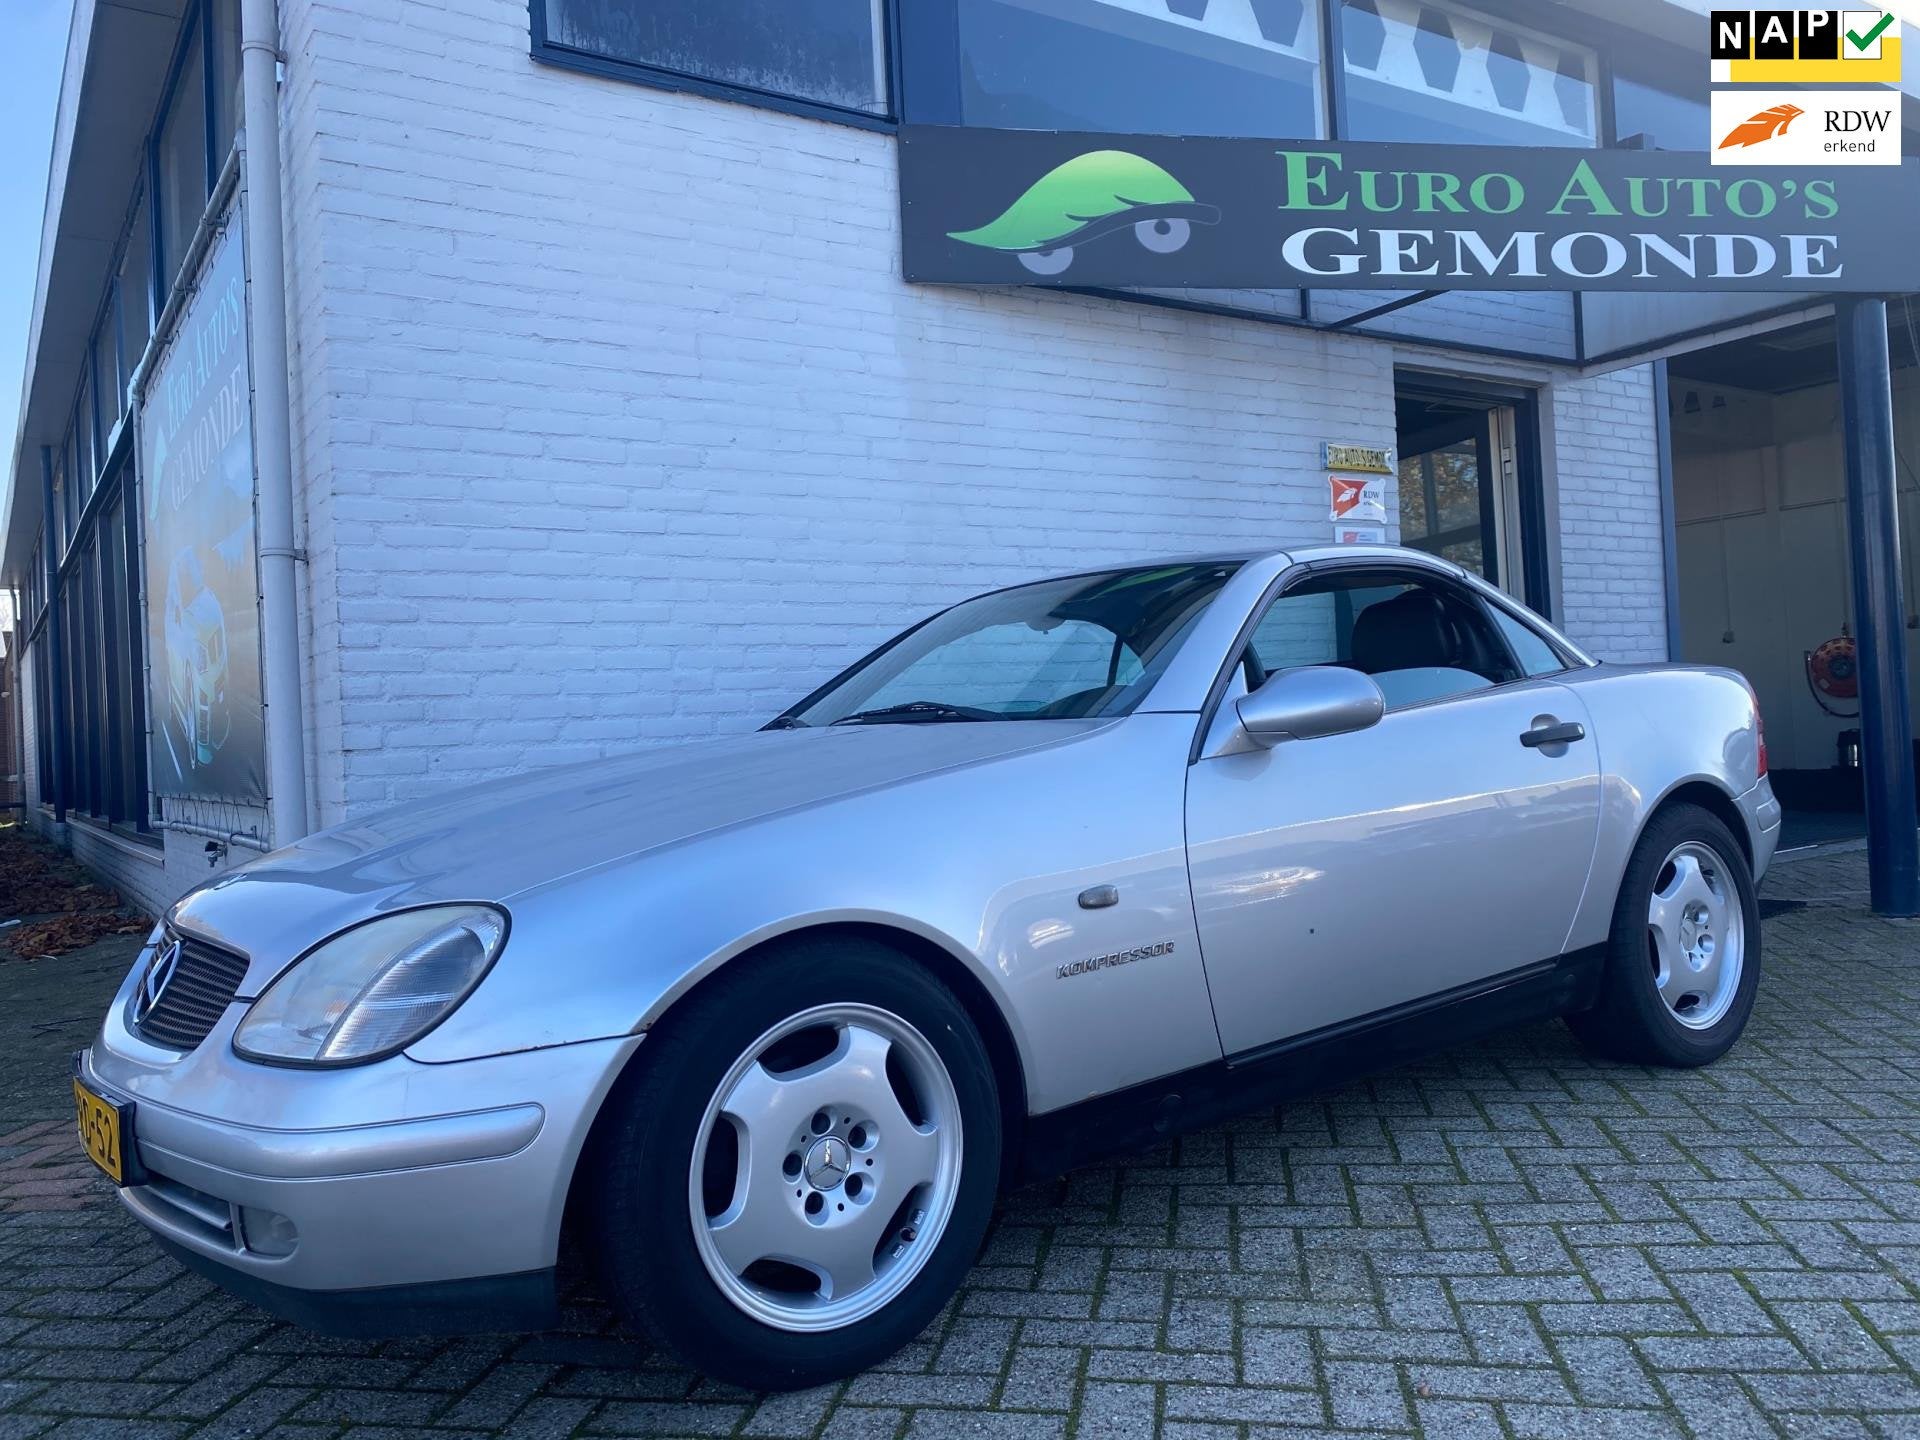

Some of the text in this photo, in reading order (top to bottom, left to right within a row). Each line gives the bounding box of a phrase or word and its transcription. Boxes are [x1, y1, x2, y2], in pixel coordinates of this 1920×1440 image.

[1275, 150, 1525, 214] EURO
[1281, 227, 1844, 280] GEMONDE
[171, 363, 244, 511] GEMONDE
[1363, 490, 1380, 499] RDW
[1056, 940, 1175, 979] KOMPRESSOR
